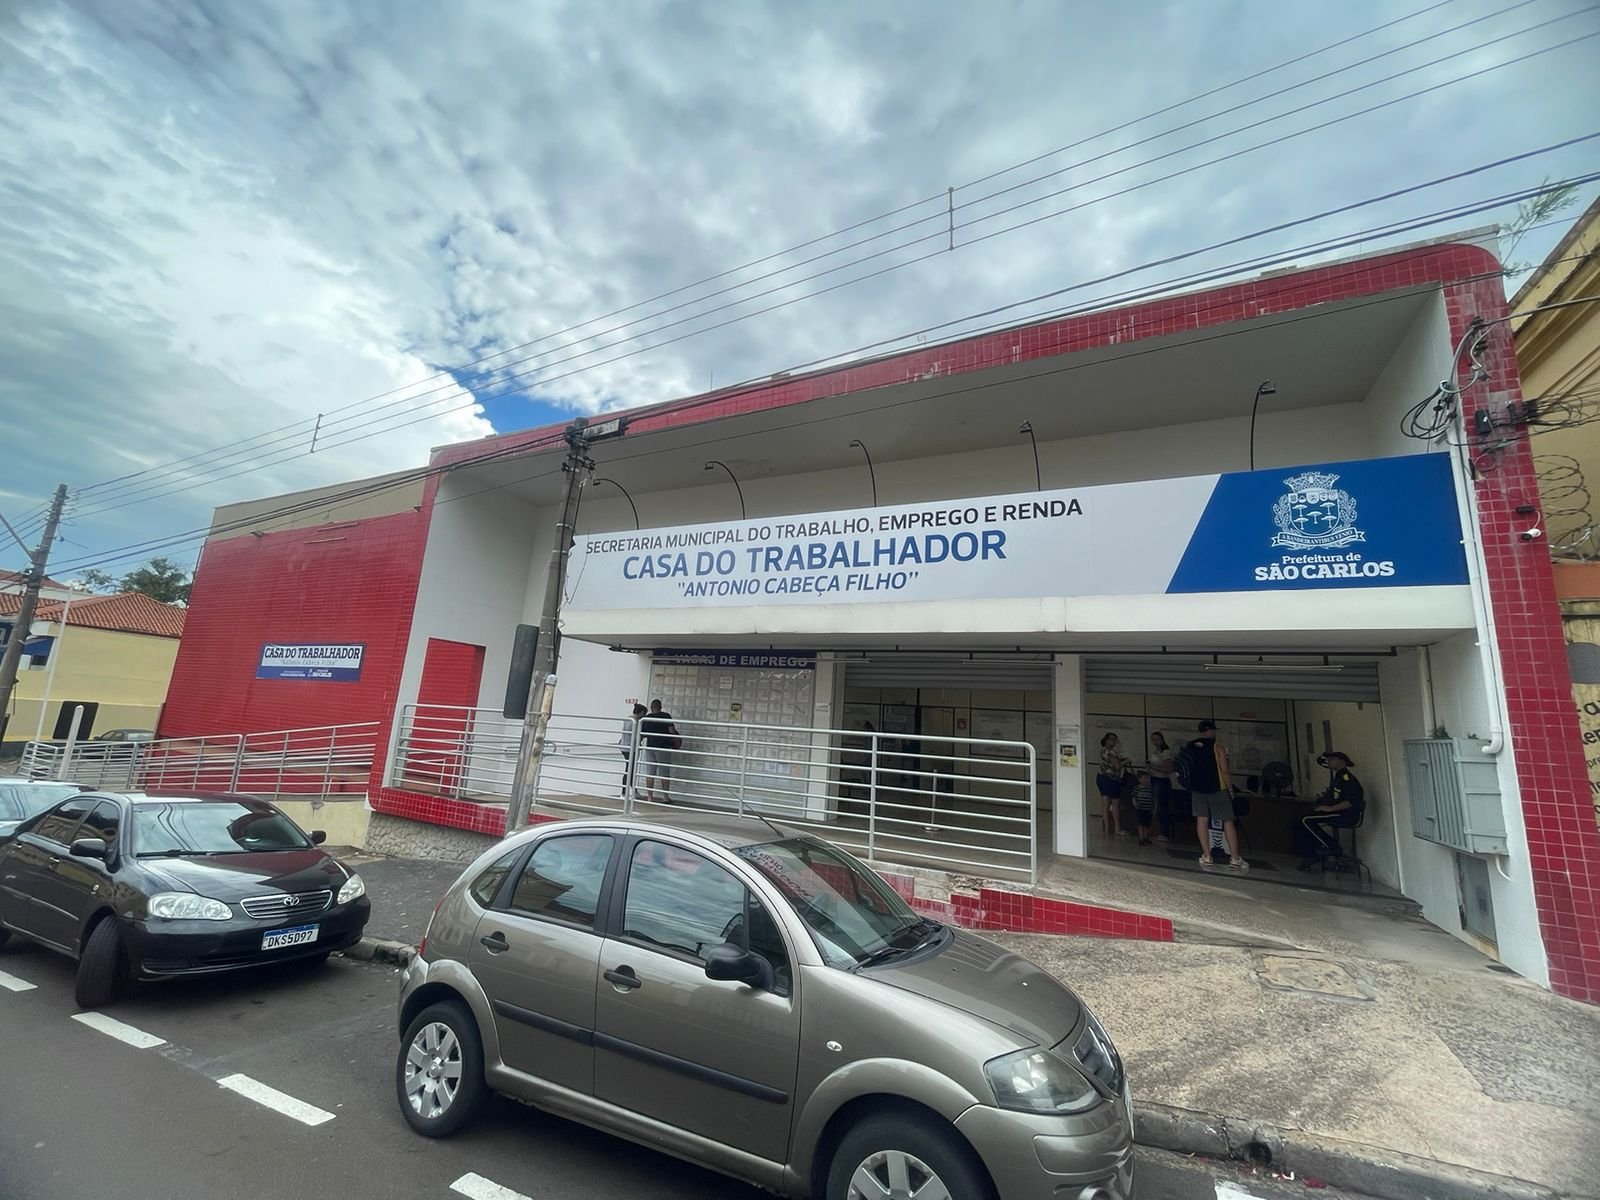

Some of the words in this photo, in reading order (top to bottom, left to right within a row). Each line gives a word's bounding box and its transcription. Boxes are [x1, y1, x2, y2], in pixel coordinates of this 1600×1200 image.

[586, 536, 662, 554] SECRETARIA
[665, 529, 744, 548] MUNICIPAL
[748, 526, 771, 541] DO
[775, 517, 874, 539] TRABALHO,
[879, 507, 979, 531] EMPREGO
[985, 506, 997, 523] E
[1003, 498, 1083, 521] RENDA
[623, 552, 689, 580] CASA
[695, 549, 736, 576] DO
[746, 529, 1007, 573] TRABALHADOR
[1282, 554, 1343, 564] Prefeitura
[1346, 552, 1361, 561] de
[1255, 563, 1299, 581] SÃO
[1301, 561, 1395, 579] CARLOS
[678, 578, 761, 597] "ANTONIO
[764, 575, 840, 596] CABEÇA
[264, 647, 284, 658] CASA
[284, 647, 297, 658] DO
[297, 647, 361, 660] TRABALHADOR
[719, 655, 737, 665] DE
[741, 655, 808, 667] EMPREGO
[267, 930, 313, 948] DKS5D97
